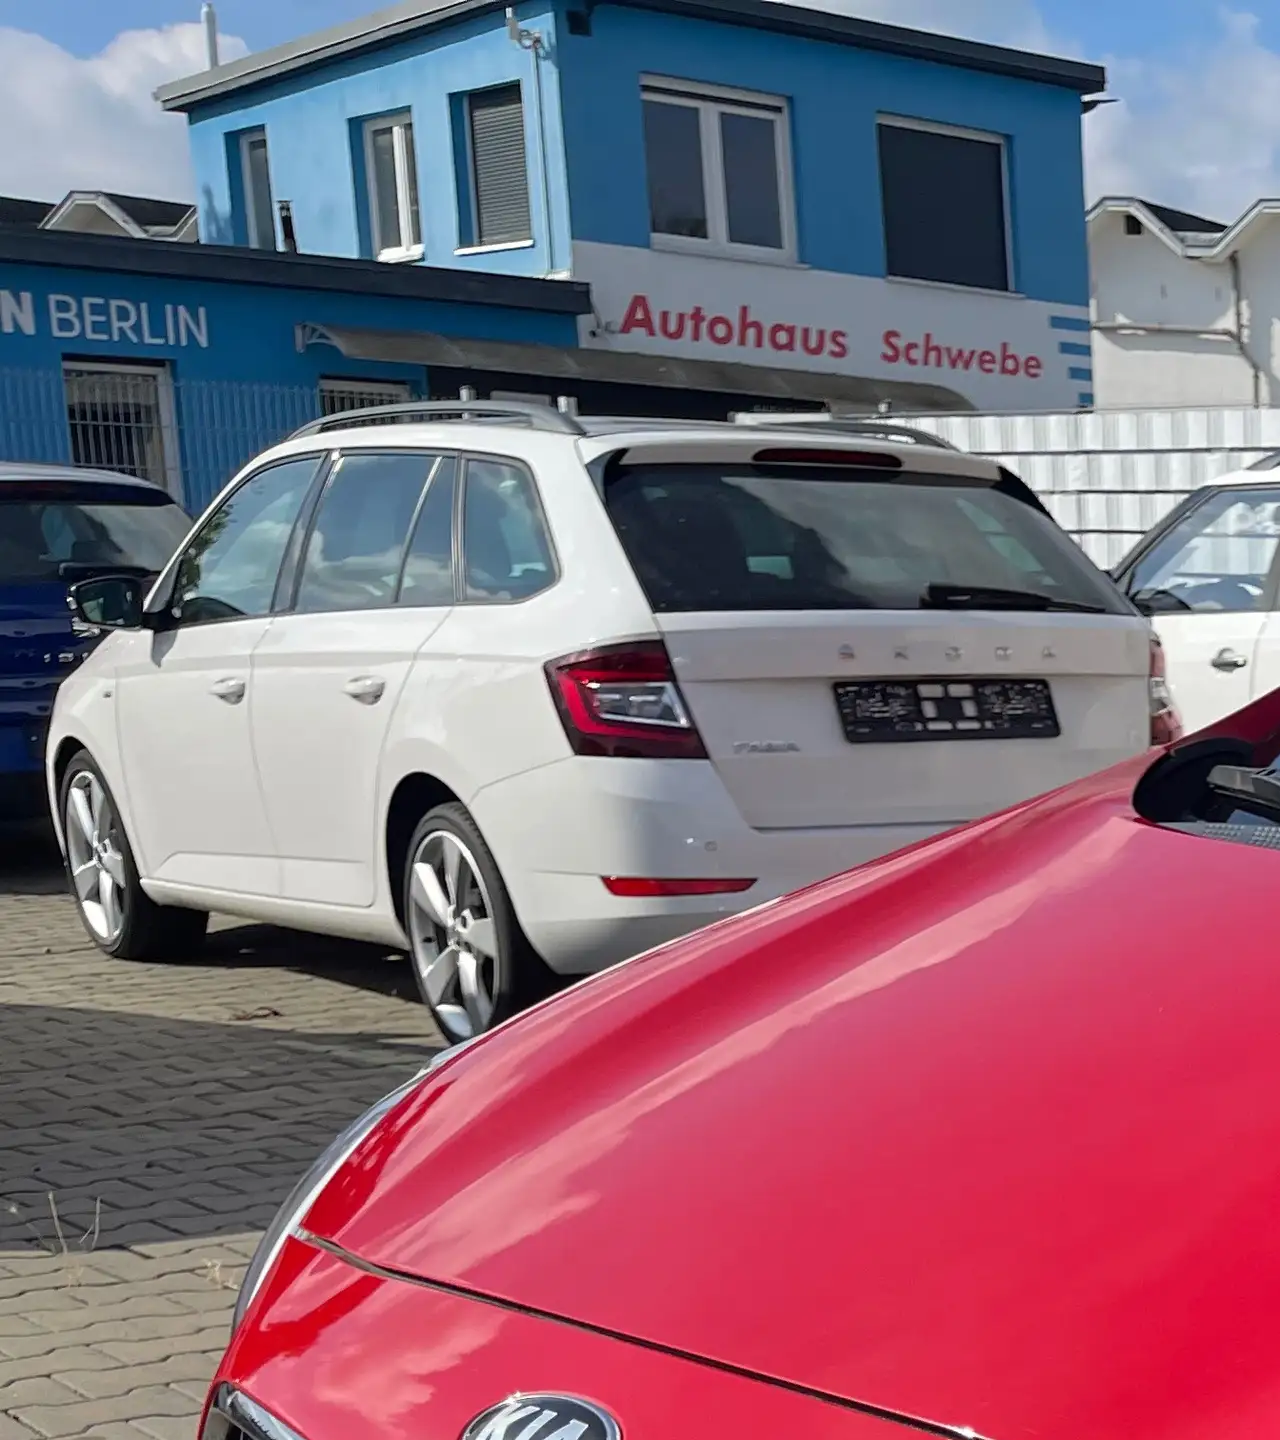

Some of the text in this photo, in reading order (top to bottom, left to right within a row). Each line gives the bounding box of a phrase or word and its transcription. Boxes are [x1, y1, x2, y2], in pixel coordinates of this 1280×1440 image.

[47, 293, 209, 348] BERLIN
[619, 295, 1044, 379] Autohaus Schwebe
